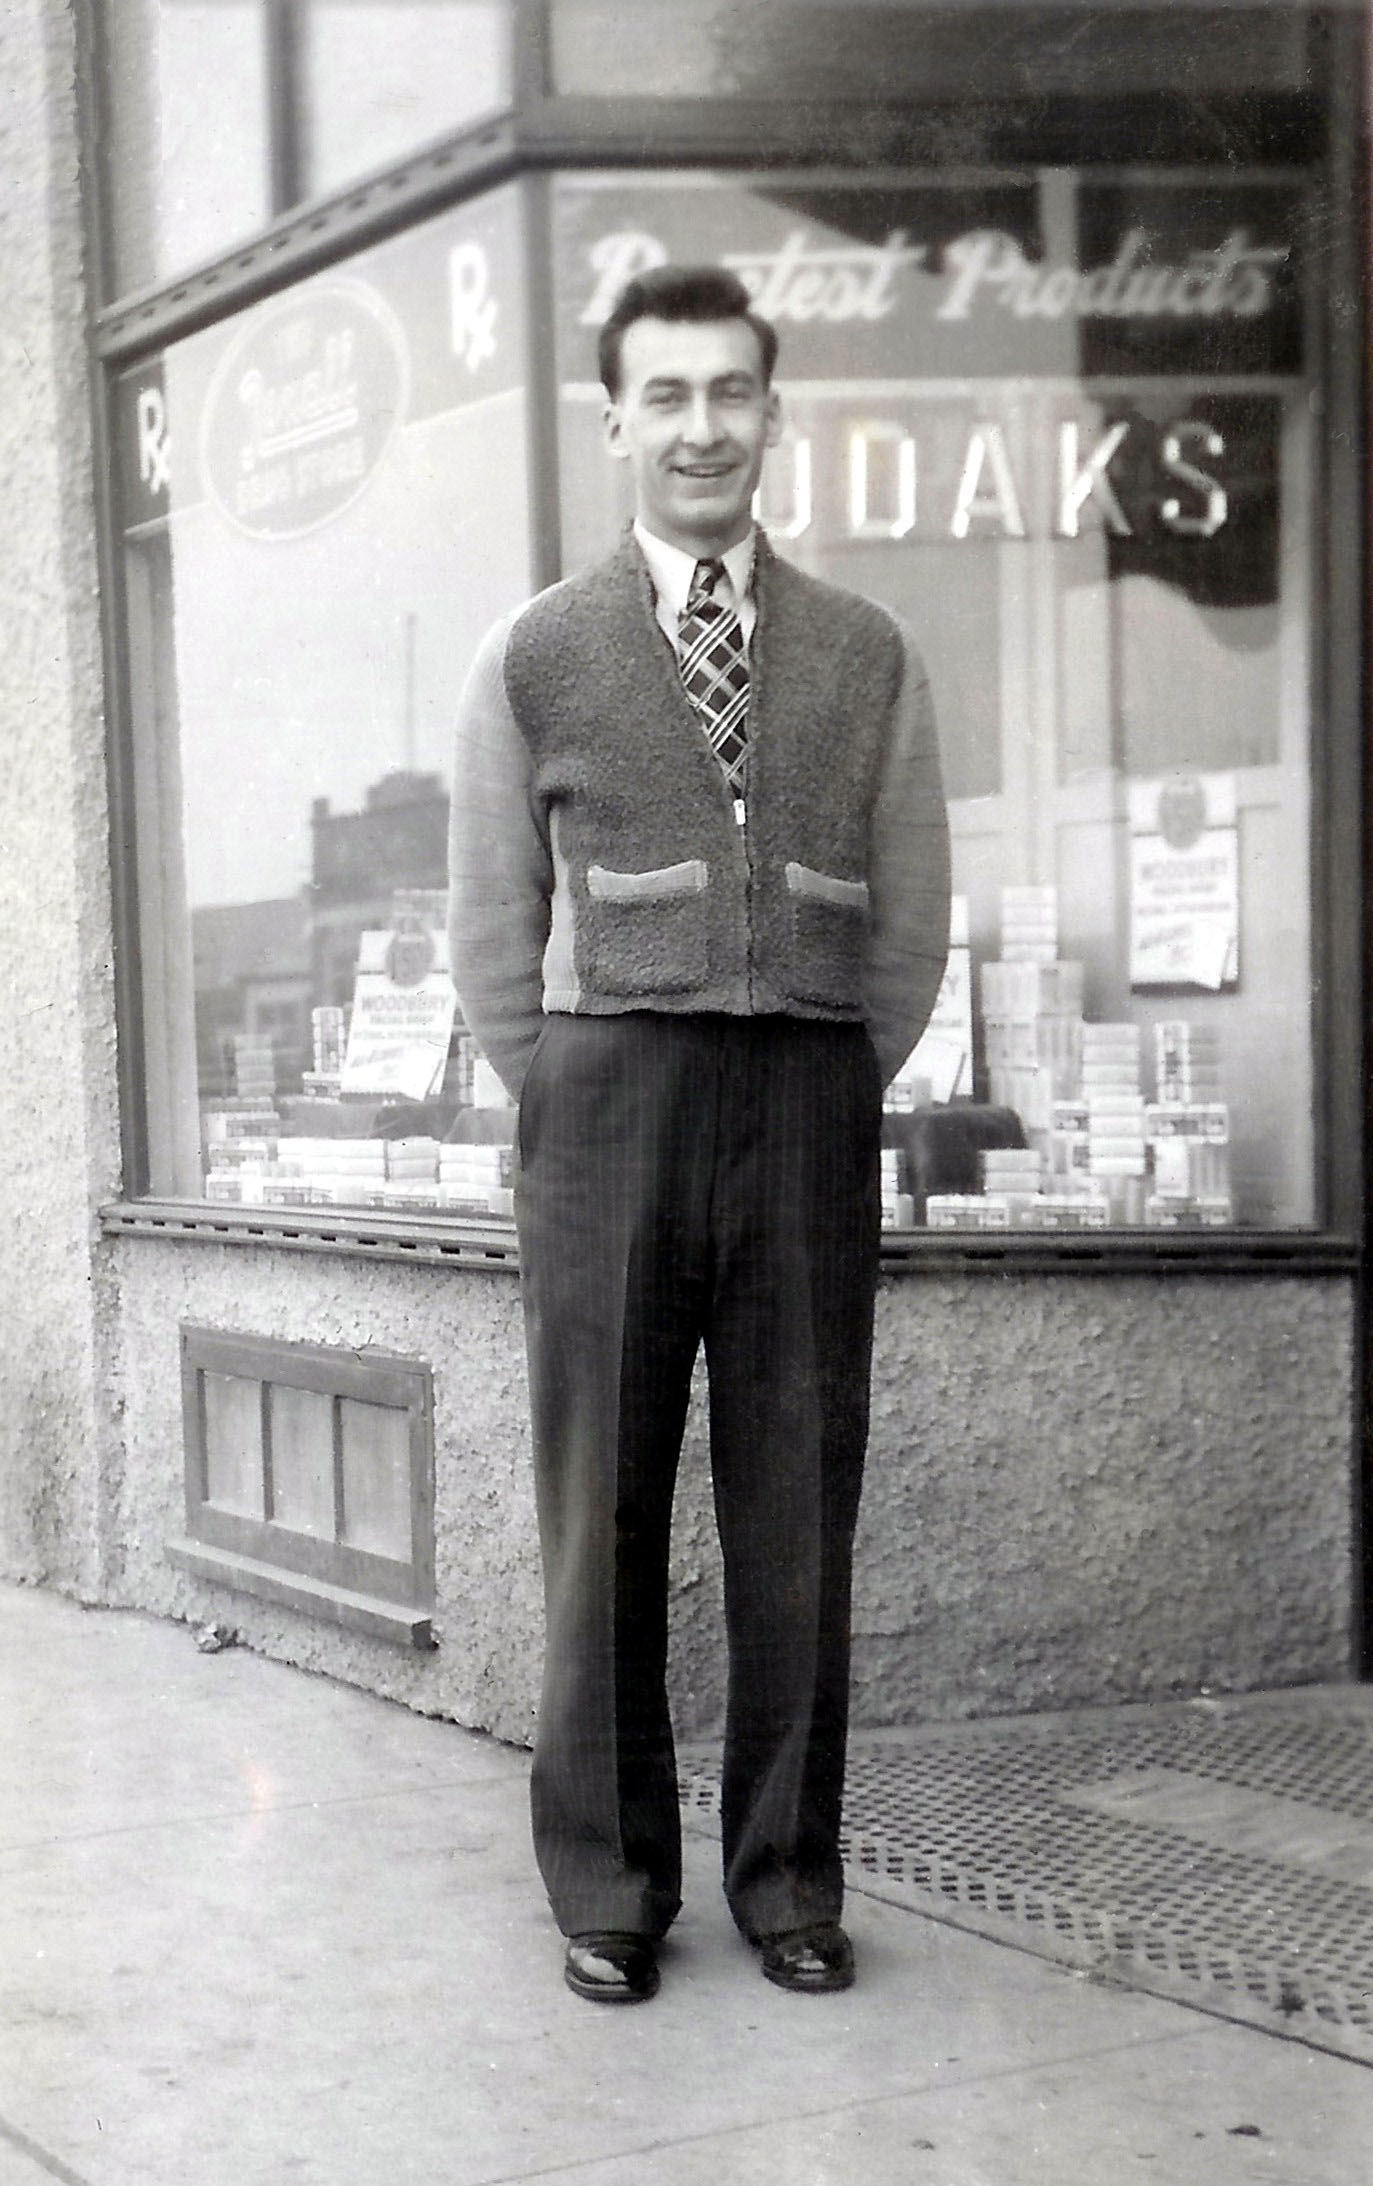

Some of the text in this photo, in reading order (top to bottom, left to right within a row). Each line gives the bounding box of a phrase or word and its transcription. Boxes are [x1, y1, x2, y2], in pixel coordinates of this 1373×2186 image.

[580, 227, 1288, 323] Ptest Products
[751, 420, 1227, 538] ODAKS
